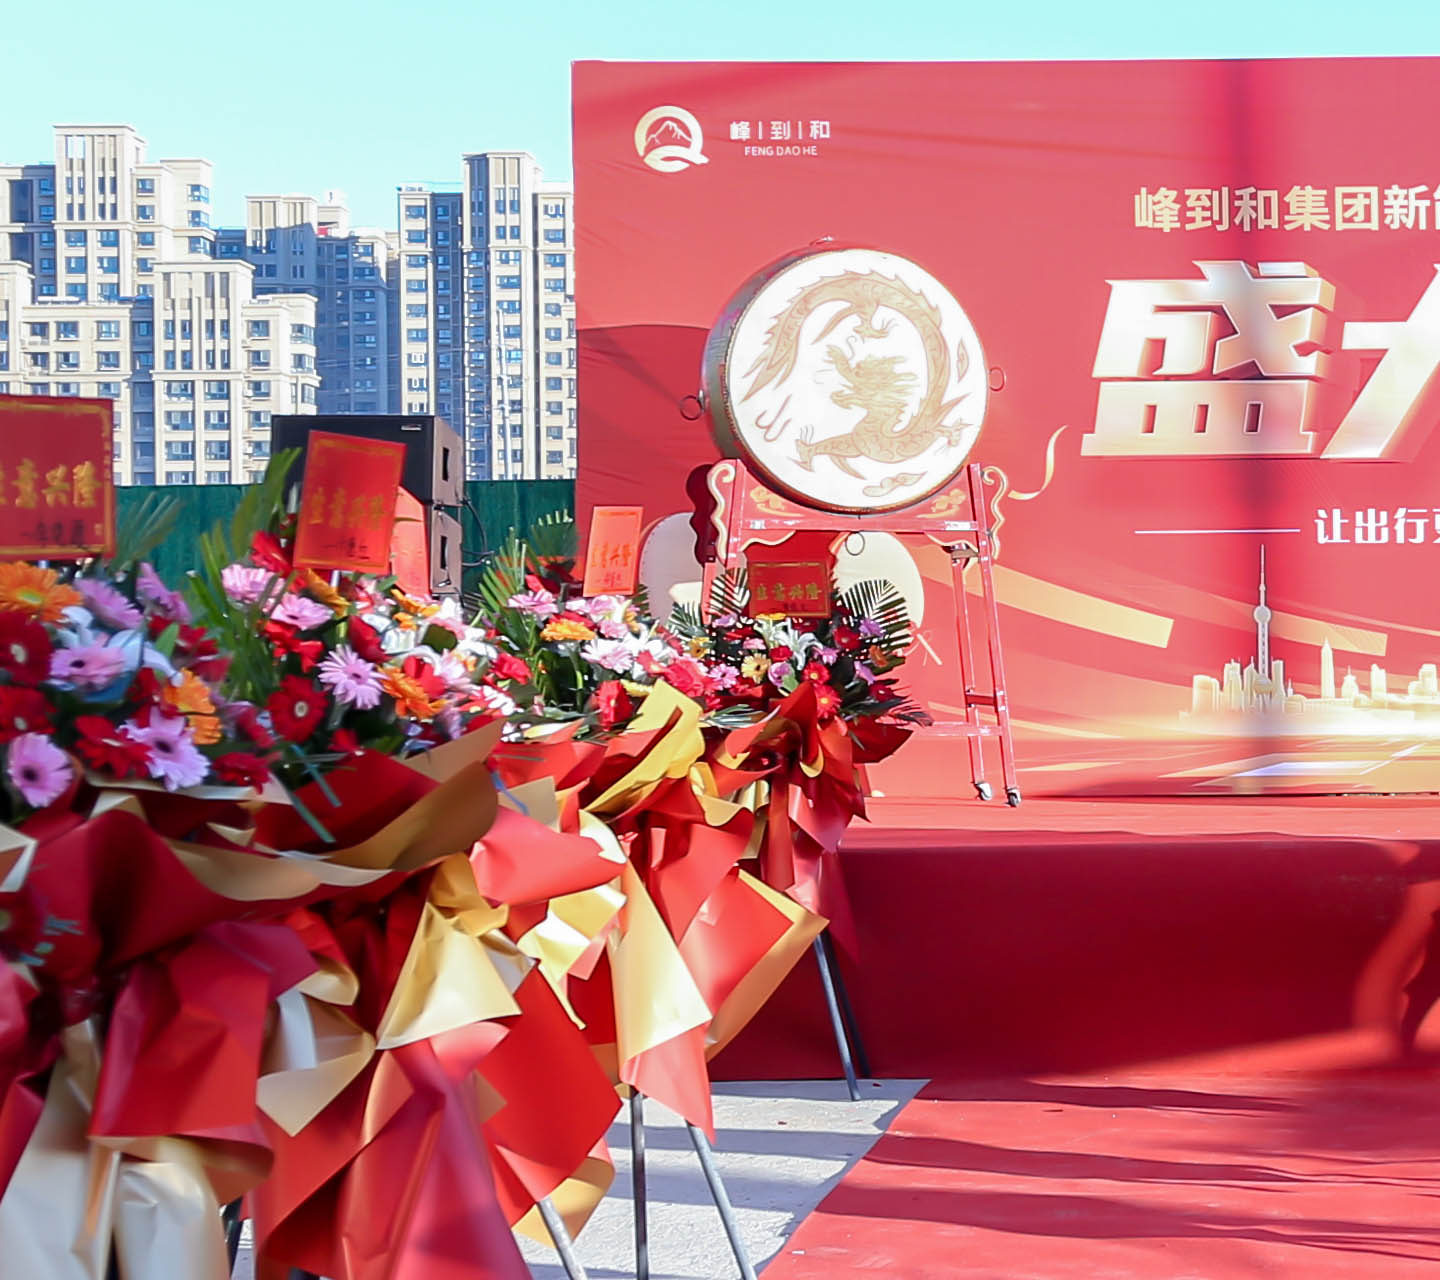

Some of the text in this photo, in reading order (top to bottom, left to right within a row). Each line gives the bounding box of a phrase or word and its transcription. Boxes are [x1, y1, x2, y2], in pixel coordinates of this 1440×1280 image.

[744, 145, 818, 157] FENG DAO HE
